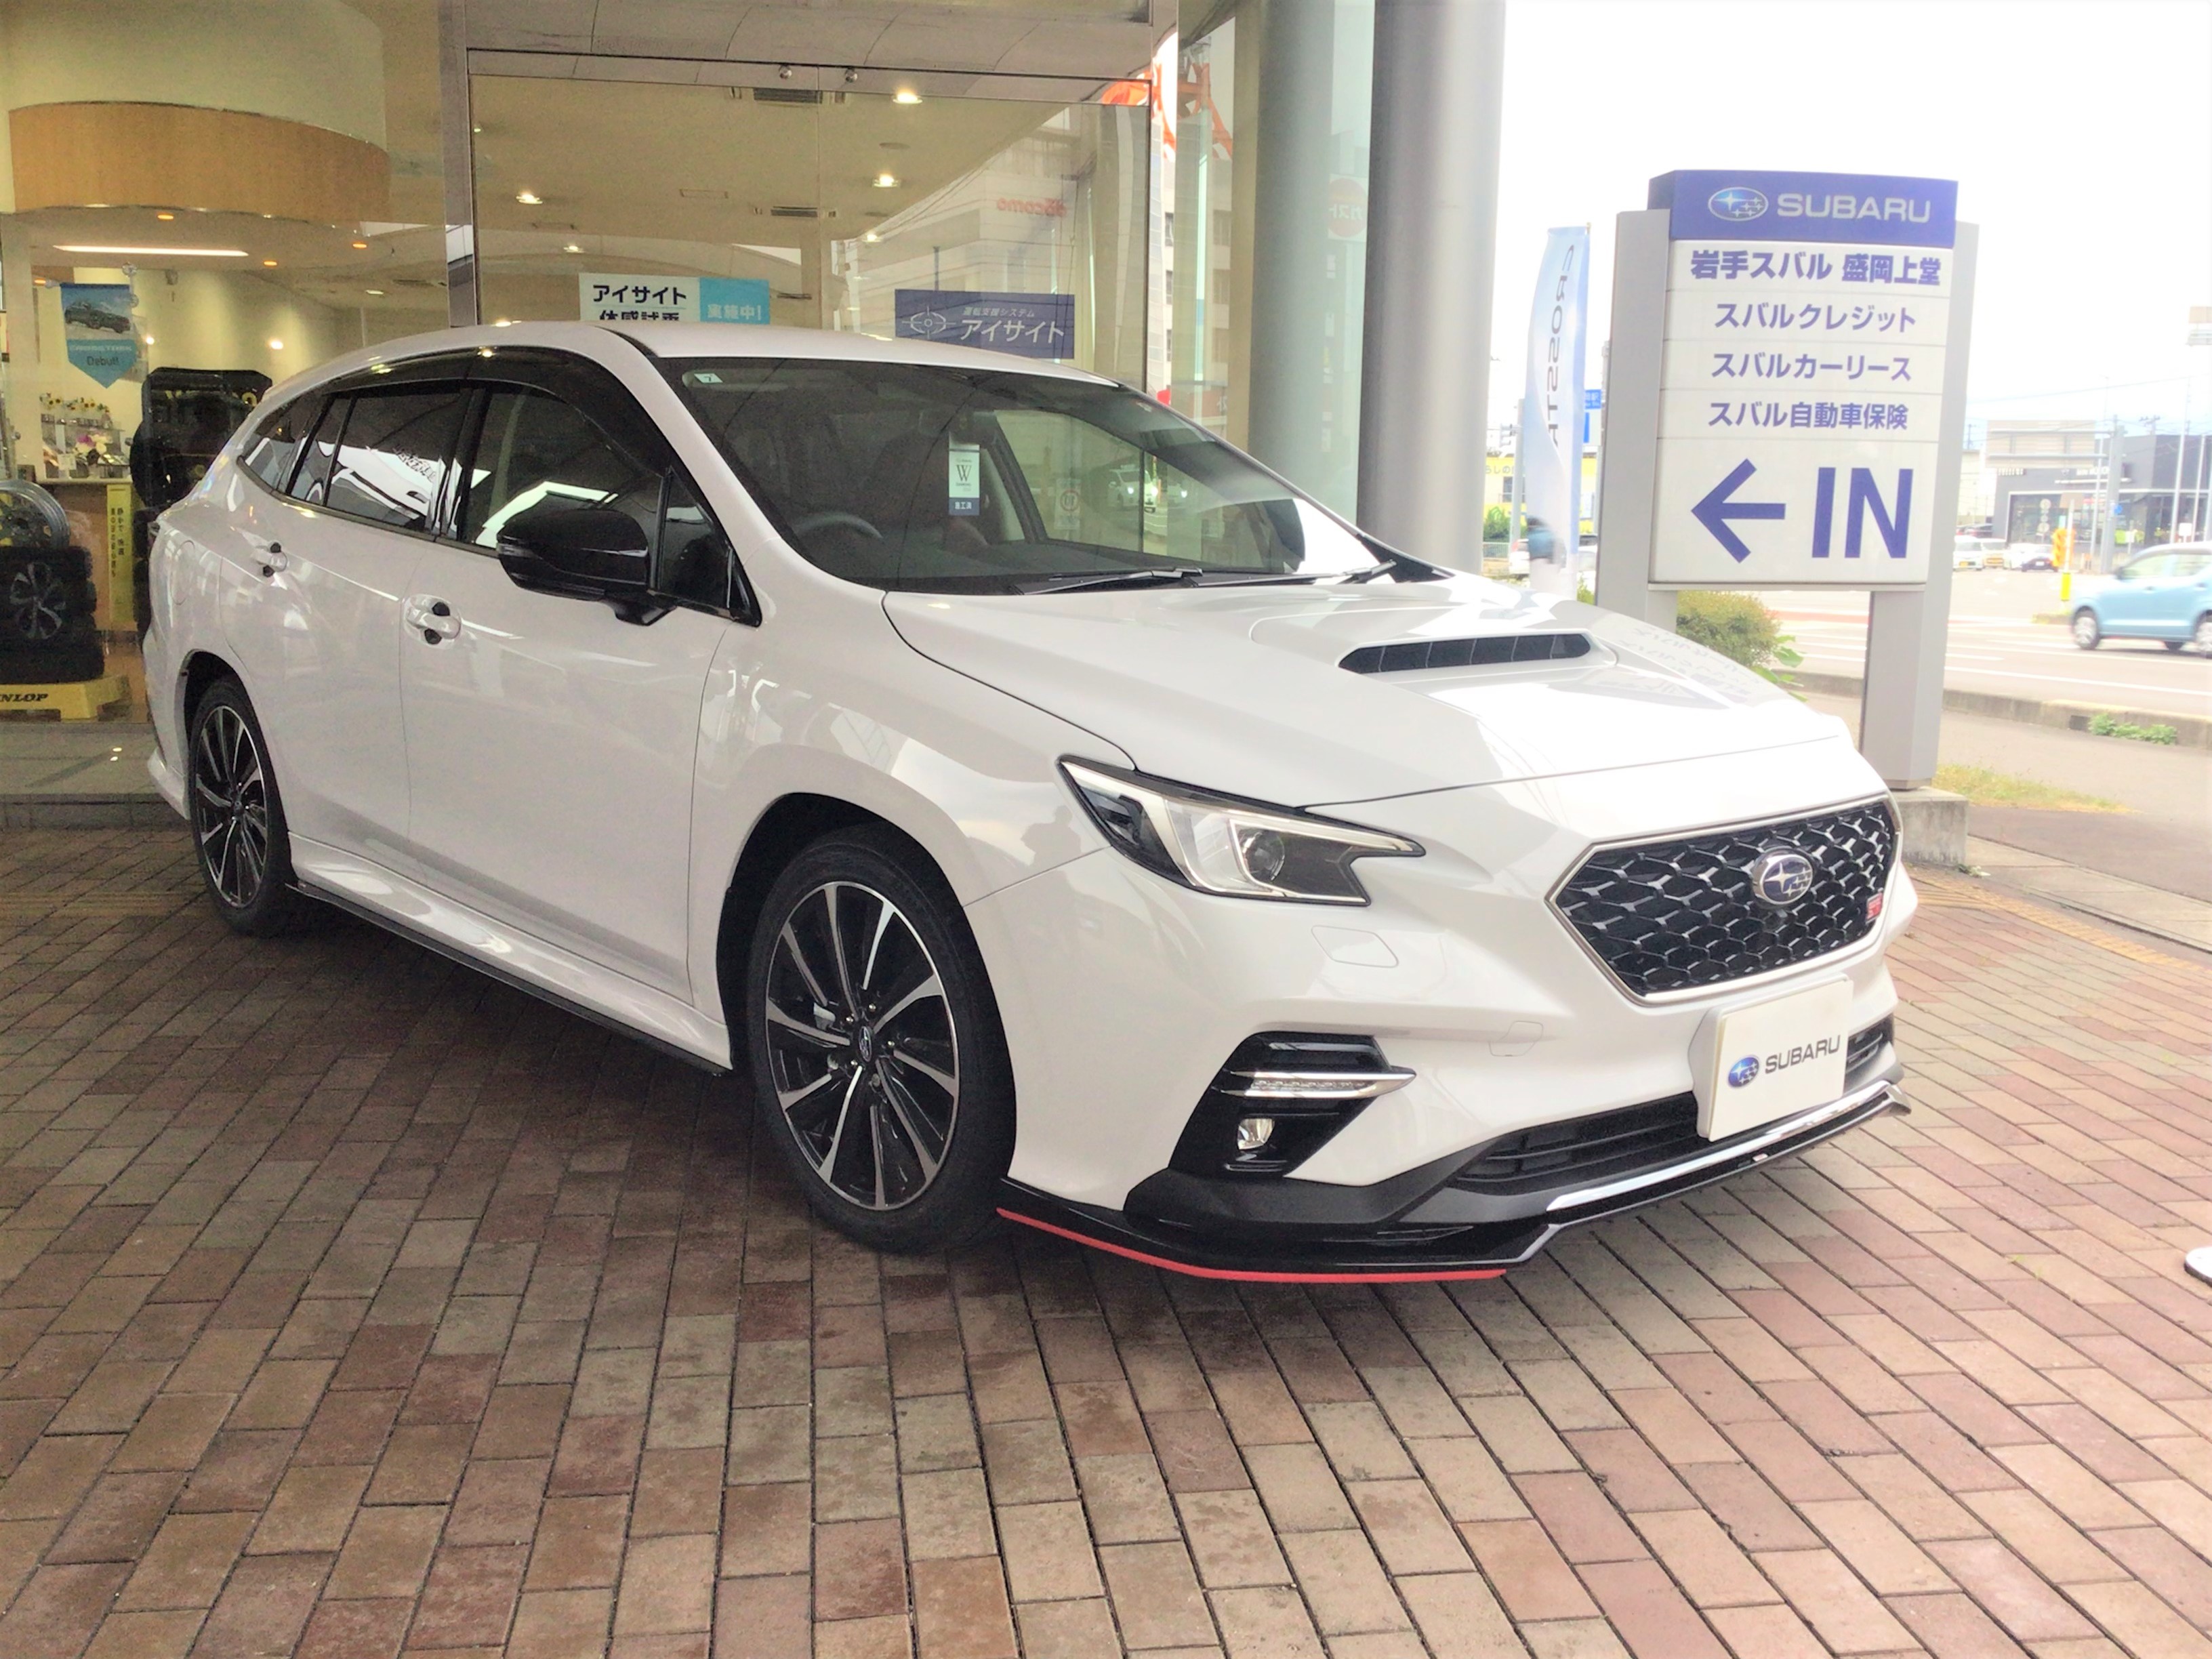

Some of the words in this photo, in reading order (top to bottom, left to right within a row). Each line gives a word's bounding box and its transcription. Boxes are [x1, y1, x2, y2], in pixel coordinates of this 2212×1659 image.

[1777, 193, 1931, 224] SUBARU
[1690, 250, 1832, 280] 岩手スバル
[1841, 253, 1942, 287] 盛岡上堂
[593, 284, 687, 305] アイサイト
[960, 320, 1065, 344] アイサイト
[1715, 302, 1916, 333] スバルクレジット
[1711, 352, 1912, 382] スバルカーリース
[1708, 401, 1910, 430] スバル自動車保険
[1811, 466, 1914, 559] IN
[0, 693, 49, 702] NLOP
[1765, 1034, 1841, 1075] SUBARU
